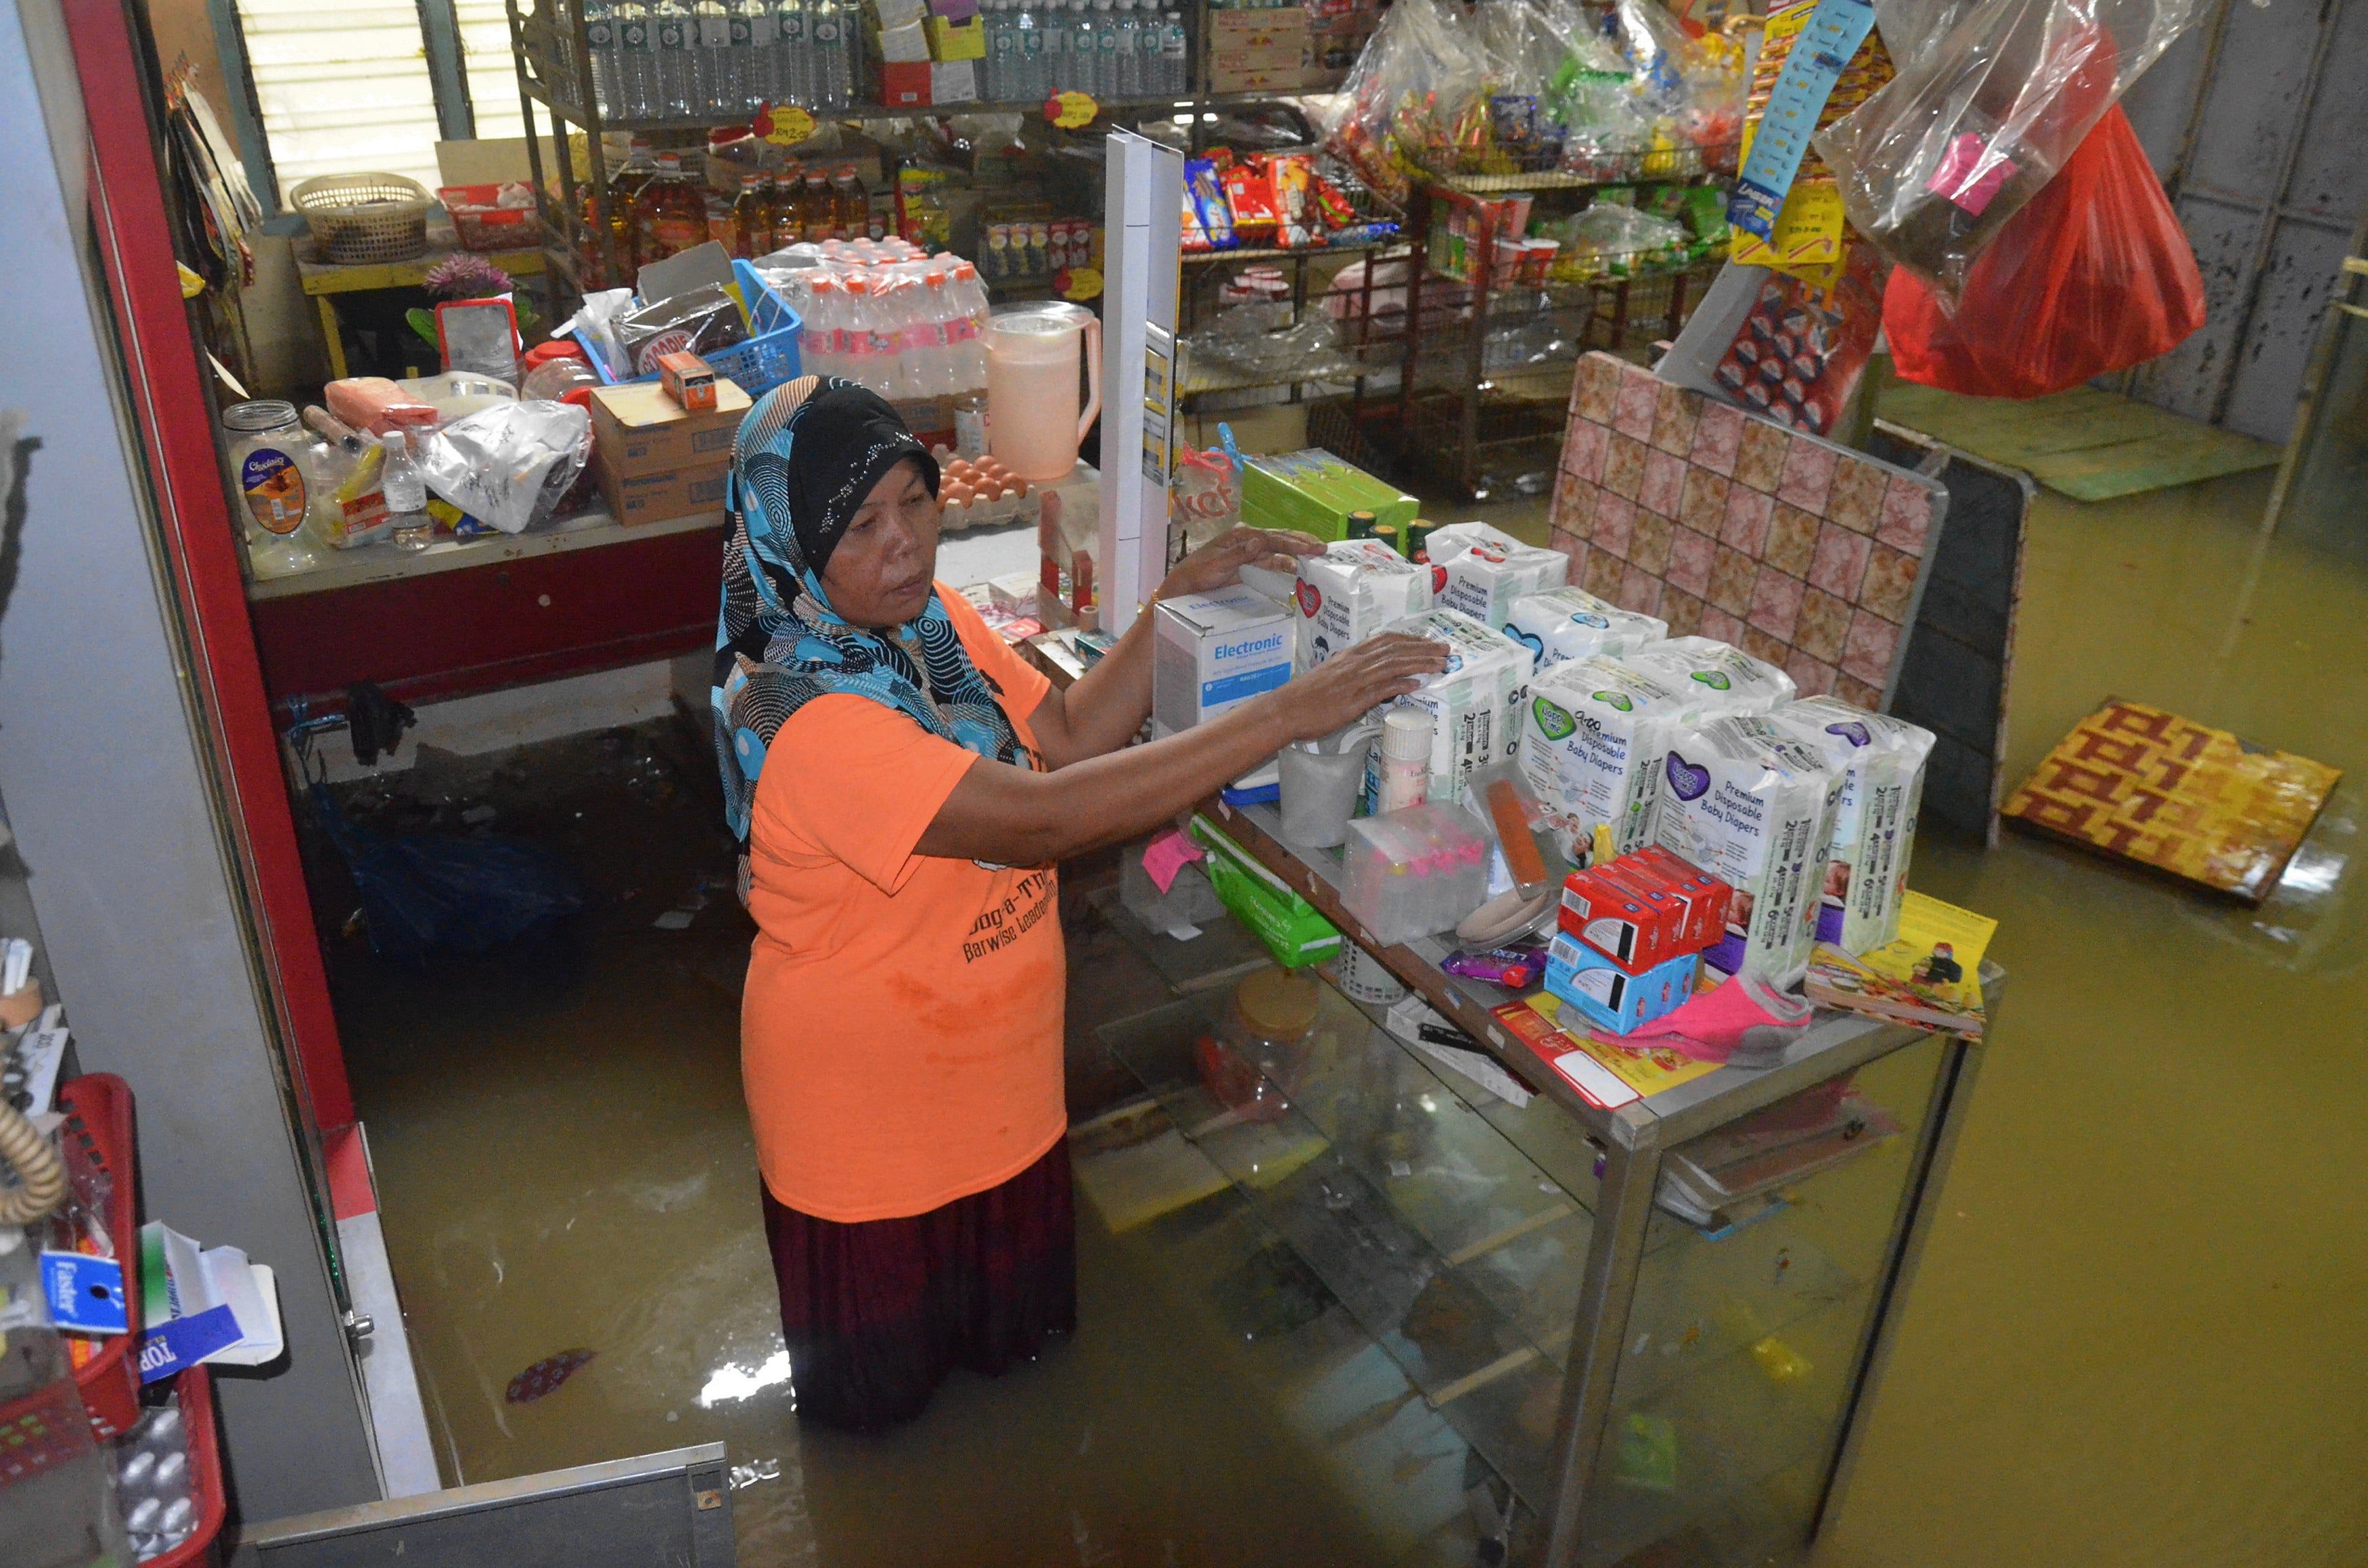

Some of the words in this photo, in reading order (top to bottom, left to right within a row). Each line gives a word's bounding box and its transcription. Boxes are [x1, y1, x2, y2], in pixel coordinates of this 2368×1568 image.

[1451, 585, 1487, 607] Disposable
[1459, 576, 1488, 595] Premium
[1323, 605, 1350, 627] Disposable
[1327, 596, 1350, 612] Premium
[1441, 594, 1457, 609] Baby
[1460, 603, 1486, 622] Diapers
[1329, 623, 1350, 640] Diapers
[1214, 633, 1283, 660] Electronic
[1566, 740, 1588, 764] Baby
[1589, 752, 1624, 776] Diapers
[1582, 731, 1626, 760] Disposable
[1715, 789, 1762, 821] Disposable
[1726, 780, 1764, 807] Premium
[1701, 799, 1723, 819] Baby
[1725, 812, 1760, 837] Diapers
[963, 926, 1017, 963] Barwise
